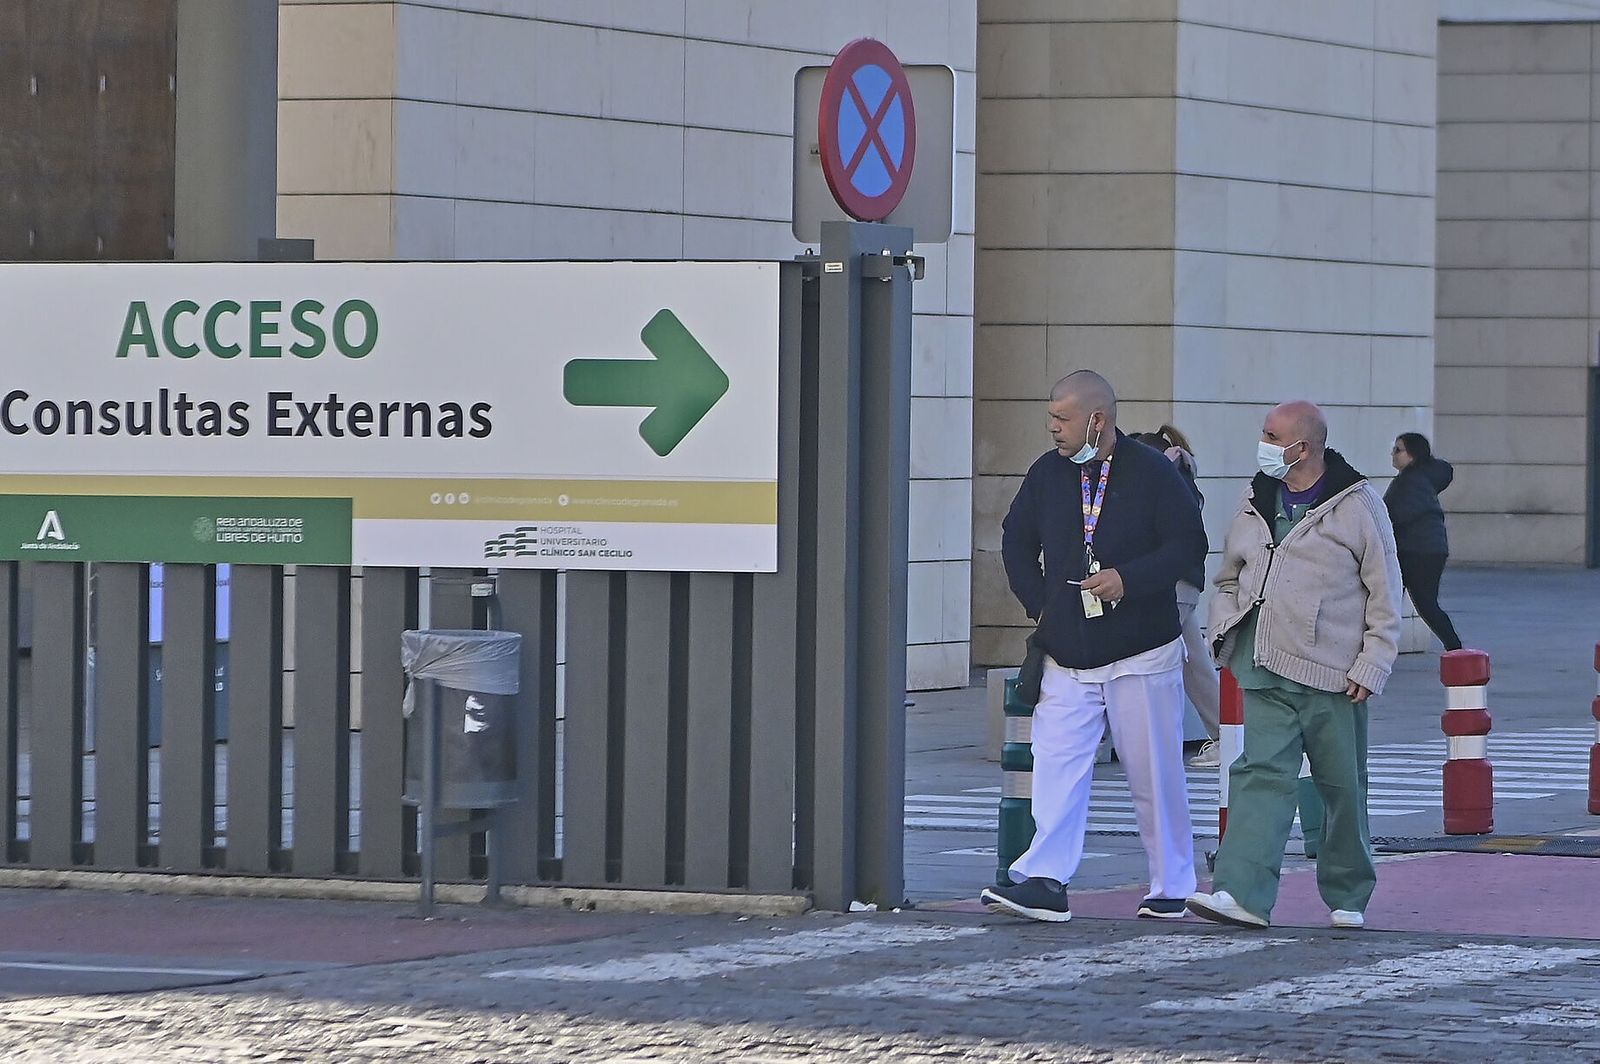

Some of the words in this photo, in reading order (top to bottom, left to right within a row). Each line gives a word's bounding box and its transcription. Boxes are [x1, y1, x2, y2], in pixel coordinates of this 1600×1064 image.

[115, 299, 379, 359] ACCESO
[0, 388, 250, 437] Consultas
[267, 391, 493, 438] Externas
[540, 526, 583, 535] HOSPITAL
[540, 537, 608, 547] UNIVERSITARIO
[540, 548, 576, 557] CLÍNICO
[577, 548, 597, 557] SAN
[598, 549, 633, 558] CECILIO
